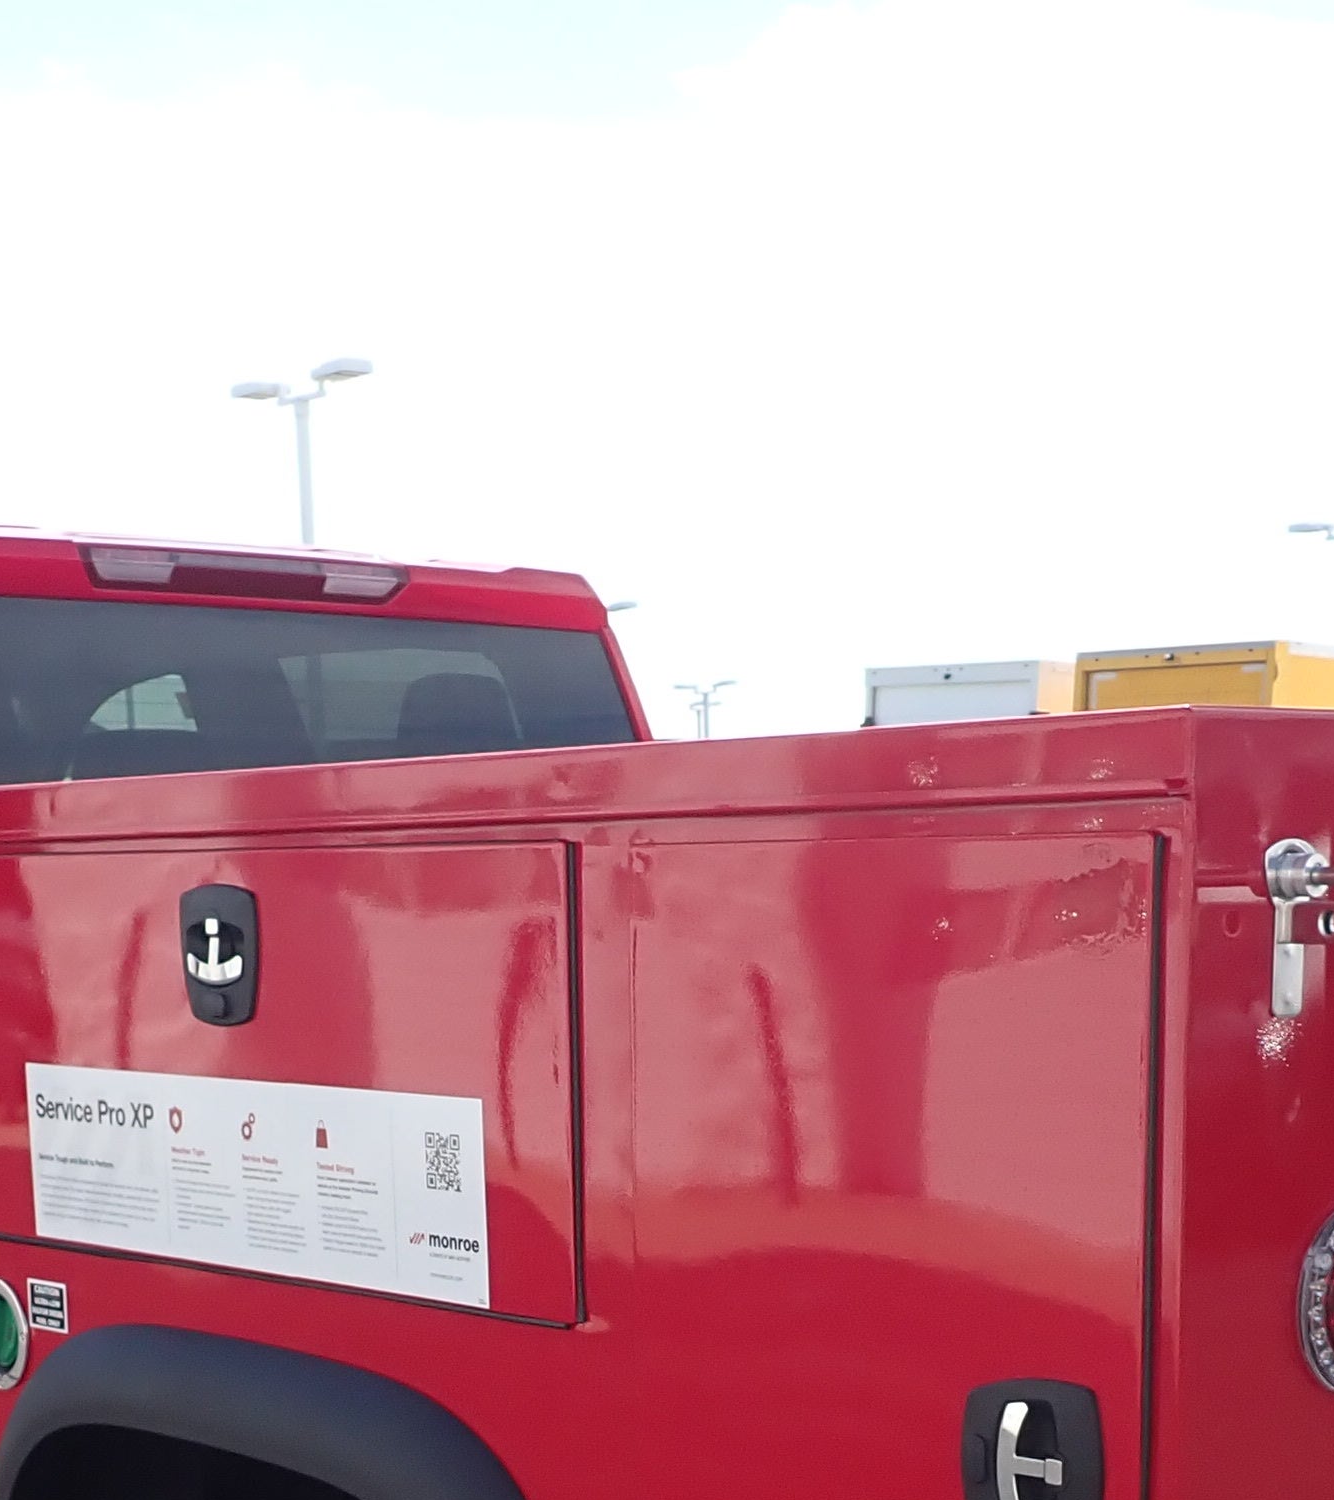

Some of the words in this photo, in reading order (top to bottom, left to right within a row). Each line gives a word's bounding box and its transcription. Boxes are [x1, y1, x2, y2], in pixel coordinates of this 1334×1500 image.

[35, 1093, 93, 1123] Service
[97, 1099, 126, 1127] Pro
[129, 1102, 155, 1129] XP
[428, 1233, 480, 1254] monroe
